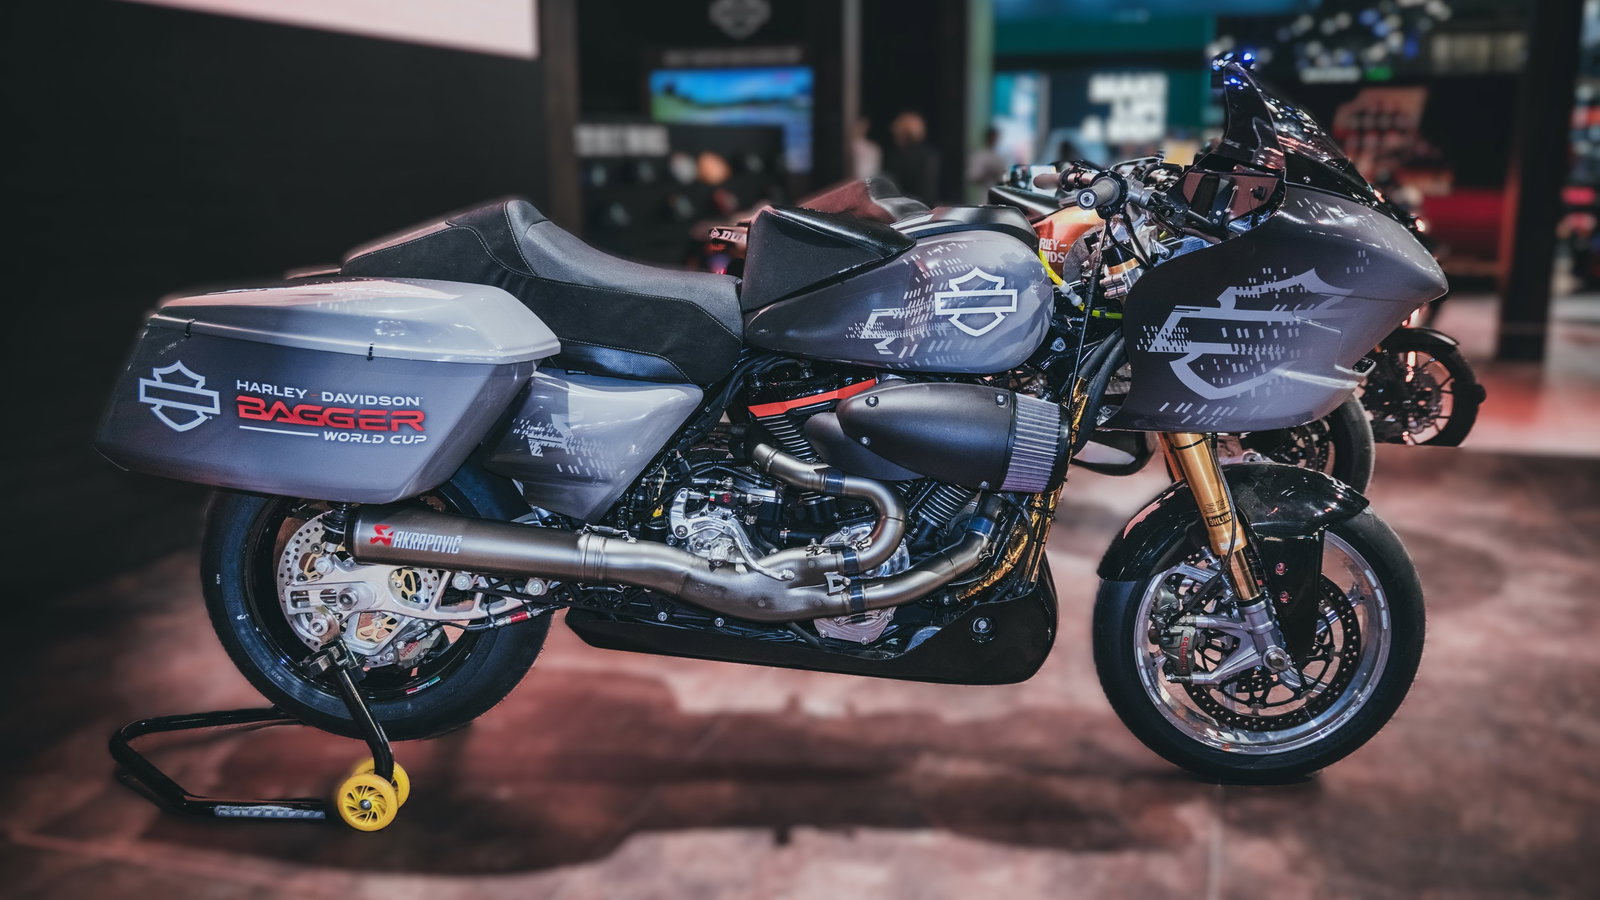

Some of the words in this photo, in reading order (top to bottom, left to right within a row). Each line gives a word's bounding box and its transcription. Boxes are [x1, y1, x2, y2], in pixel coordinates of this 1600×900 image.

[236, 395, 426, 432] BAGGER
[323, 431, 385, 444] WORLD
[390, 435, 427, 445] CUP
